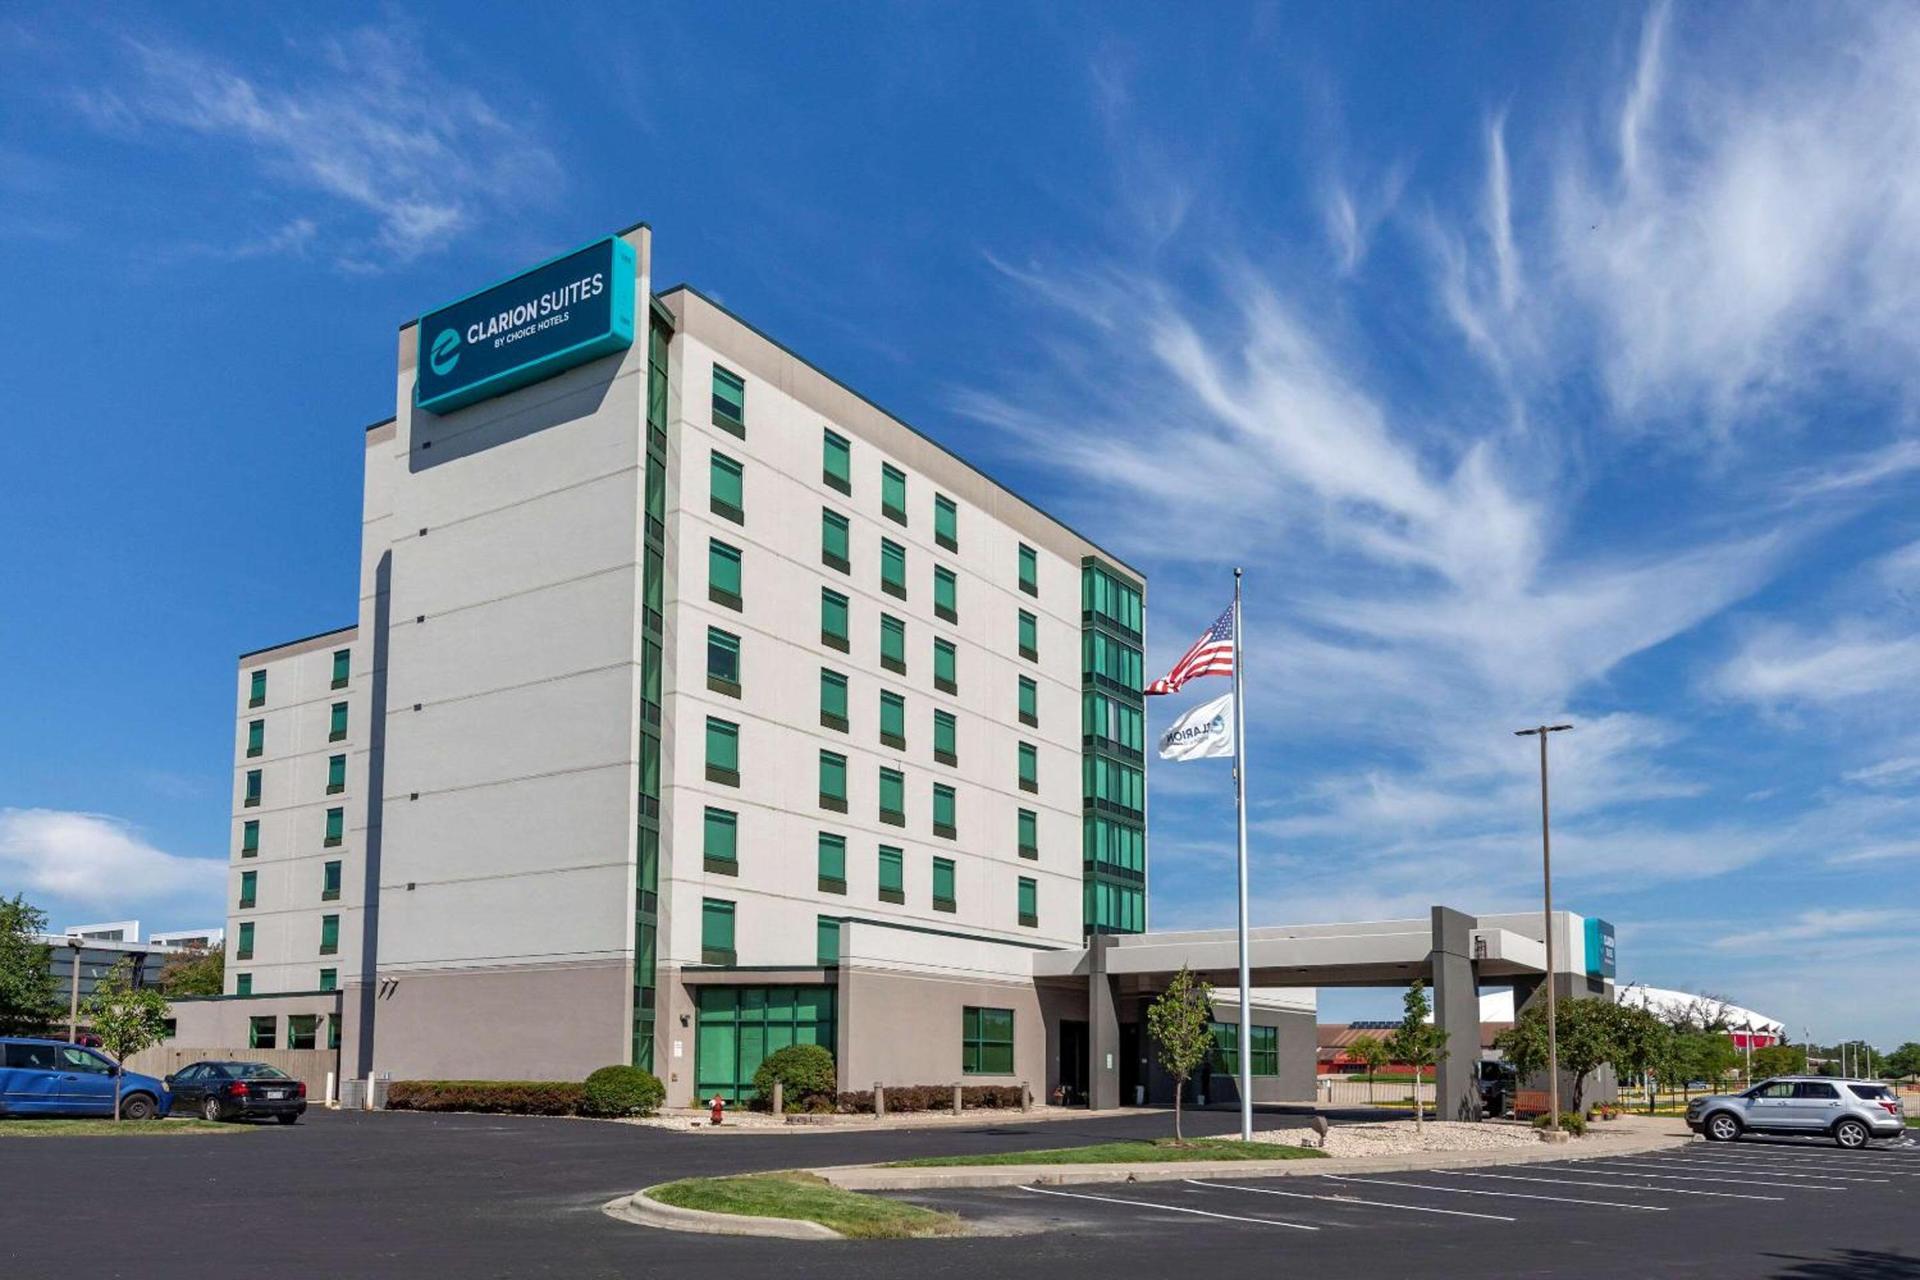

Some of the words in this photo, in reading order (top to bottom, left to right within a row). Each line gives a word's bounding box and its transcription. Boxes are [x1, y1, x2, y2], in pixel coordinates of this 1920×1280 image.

[467, 300, 538, 344] CLARION
[540, 273, 603, 315] SUITES
[494, 338, 505, 348] BY
[506, 325, 536, 343] CHOICE
[538, 312, 569, 331] HOTELS
